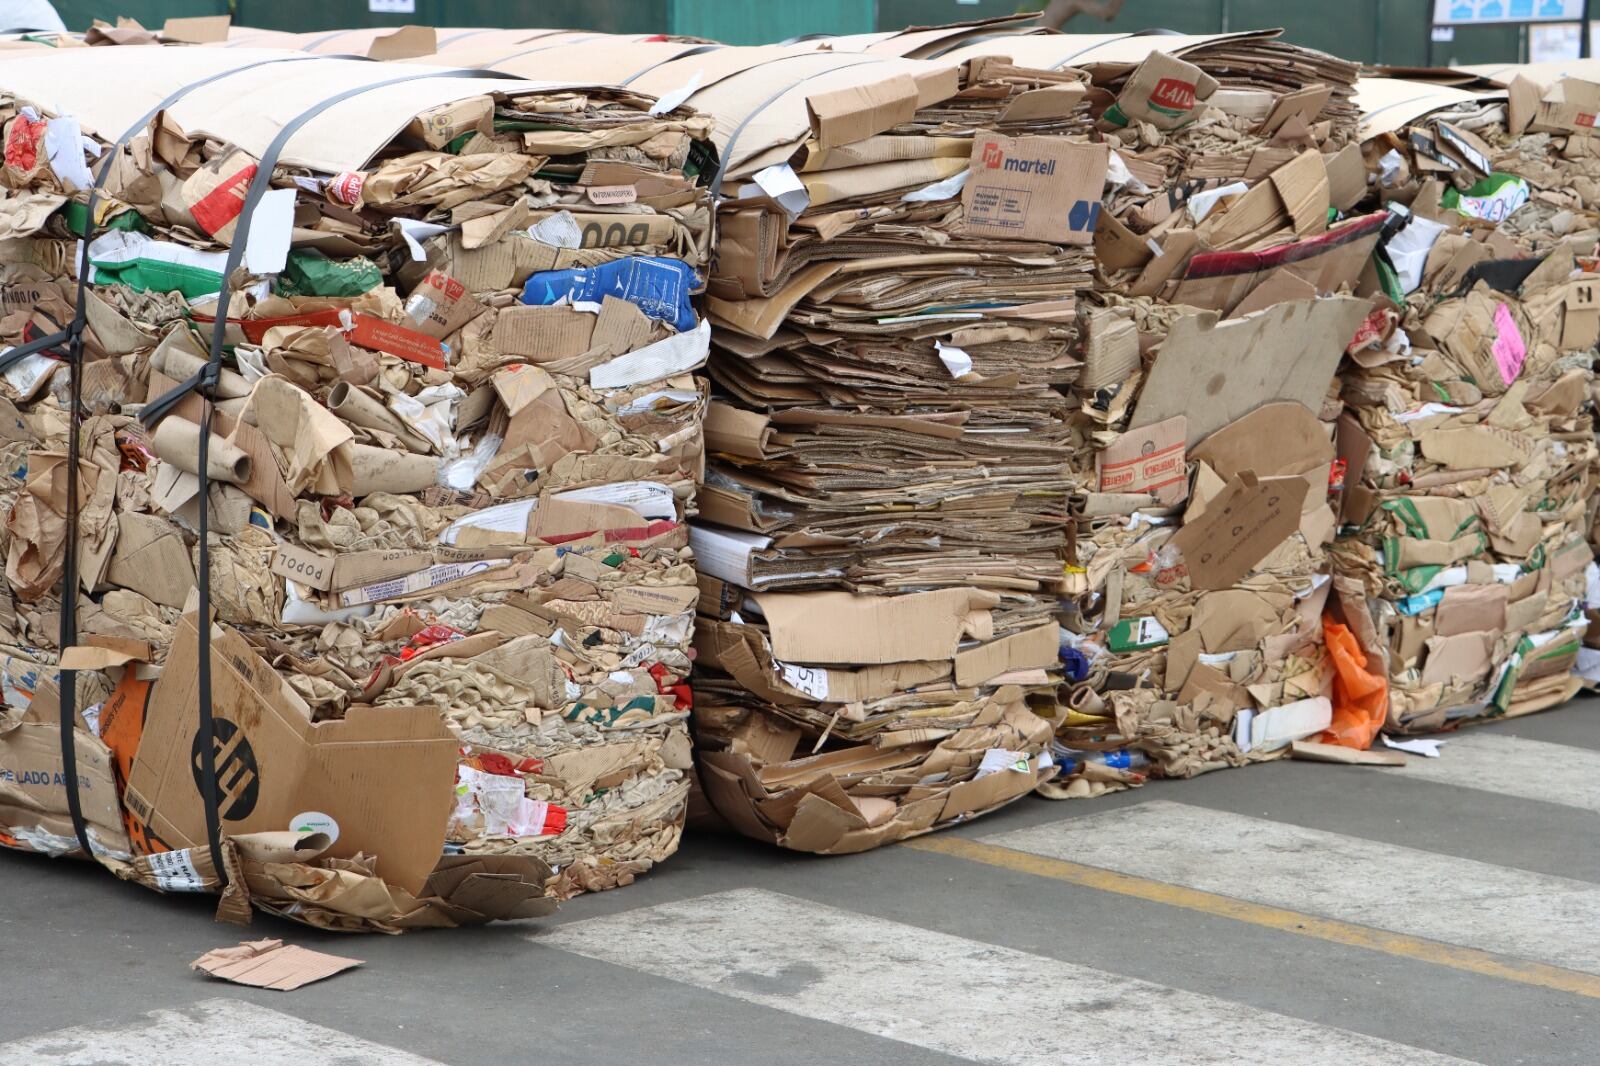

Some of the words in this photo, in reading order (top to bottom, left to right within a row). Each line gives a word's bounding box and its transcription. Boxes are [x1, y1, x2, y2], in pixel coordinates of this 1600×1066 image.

[1004, 157, 1056, 176] martell
[280, 554, 323, 580] POPOL
[16, 771, 50, 785] LADO
